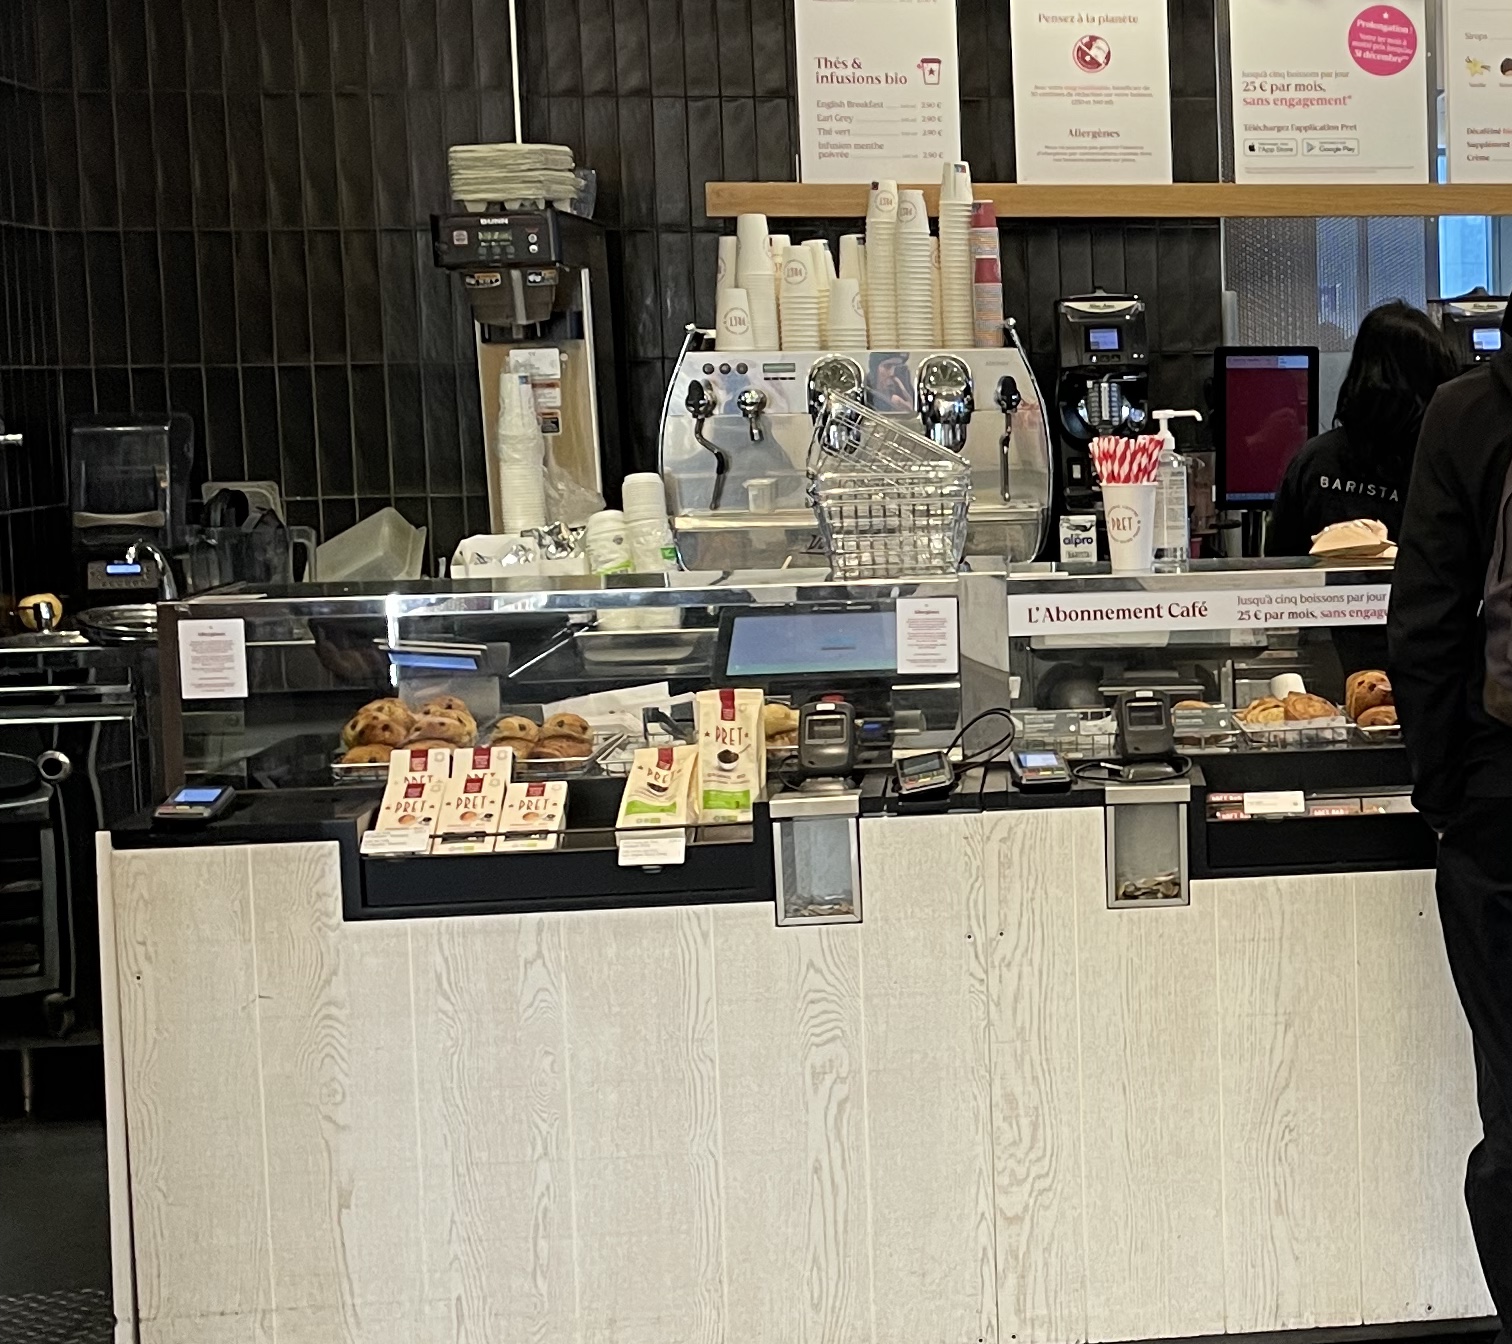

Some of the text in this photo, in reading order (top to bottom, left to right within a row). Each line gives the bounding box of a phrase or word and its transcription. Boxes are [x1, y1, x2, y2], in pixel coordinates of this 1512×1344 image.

[1038, 13, 1138, 26] Pensez à la planète
[814, 56, 863, 69] Thés &
[816, 71, 908, 84] infusions bio
[1242, 80, 1326, 94] 25 € par mois,
[817, 100, 884, 110] English Breakfast
[1243, 97, 1270, 106] sans
[817, 114, 854, 124] Earl Grey
[817, 128, 833, 136] Thé
[1068, 128, 1120, 139] Allergènes
[818, 142, 884, 150] Infusion menthe
[1319, 145, 1355, 153] Google Play
[1320, 476, 1399, 502] BARISTA
[1111, 516, 1132, 531] PRET
[1063, 534, 1094, 547] alpro
[1237, 592, 1387, 606] Jusqu'à cinq boissons par jour
[1028, 601, 1208, 623] L'Abonnement Café
[1237, 610, 1251, 621] 25
[1254, 610, 1262, 620] €
[1264, 610, 1283, 622] par
[1288, 608, 1318, 619] mois,
[1320, 609, 1347, 618] sans
[715, 725, 743, 746] PRET
[647, 768, 676, 784] PRET
[395, 800, 426, 813] PRET
[456, 795, 487, 810] PRET
[518, 798, 550, 811] PRET
